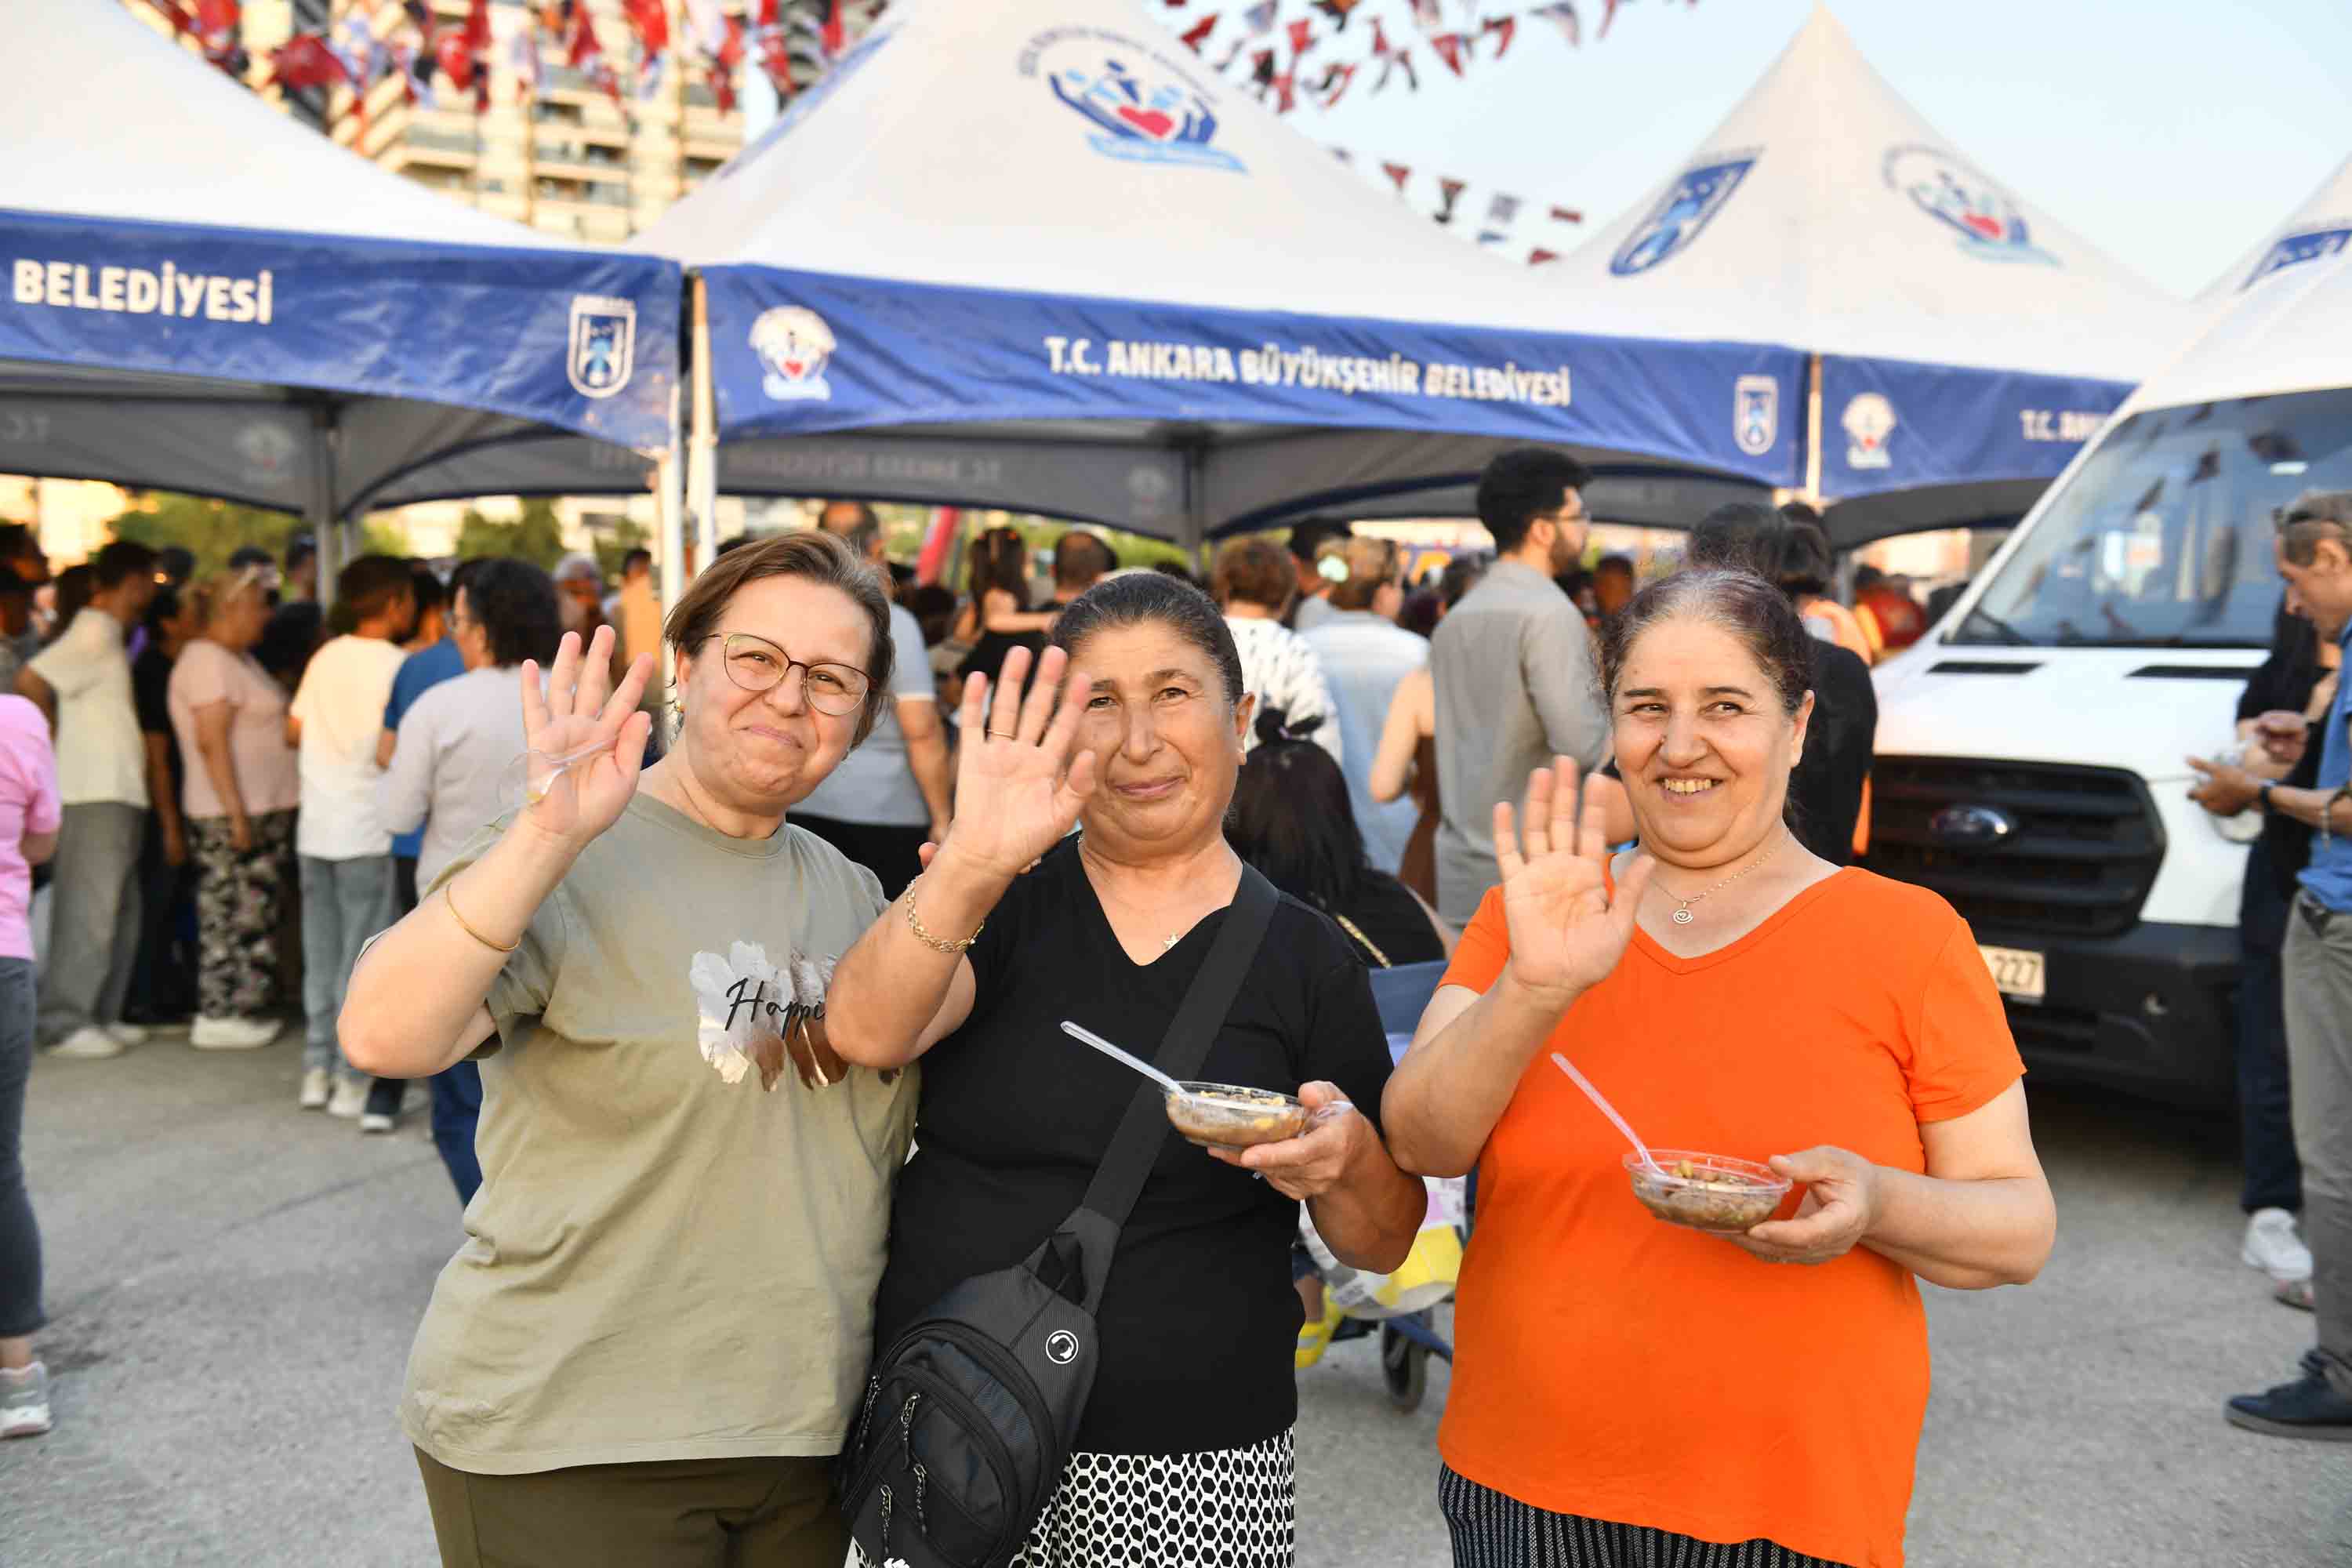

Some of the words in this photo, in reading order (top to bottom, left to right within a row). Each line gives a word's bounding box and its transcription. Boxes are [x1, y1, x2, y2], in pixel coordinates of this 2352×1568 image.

[13, 259, 273, 325] BELEDİYESİ
[1044, 336, 1102, 376] T.C.
[1107, 340, 1236, 382] ANKARA
[1239, 342, 1420, 395] BÜYÜKŞEHİR
[1424, 361, 1571, 406] BELEDİYESİ
[724, 978, 826, 1041] Happi
